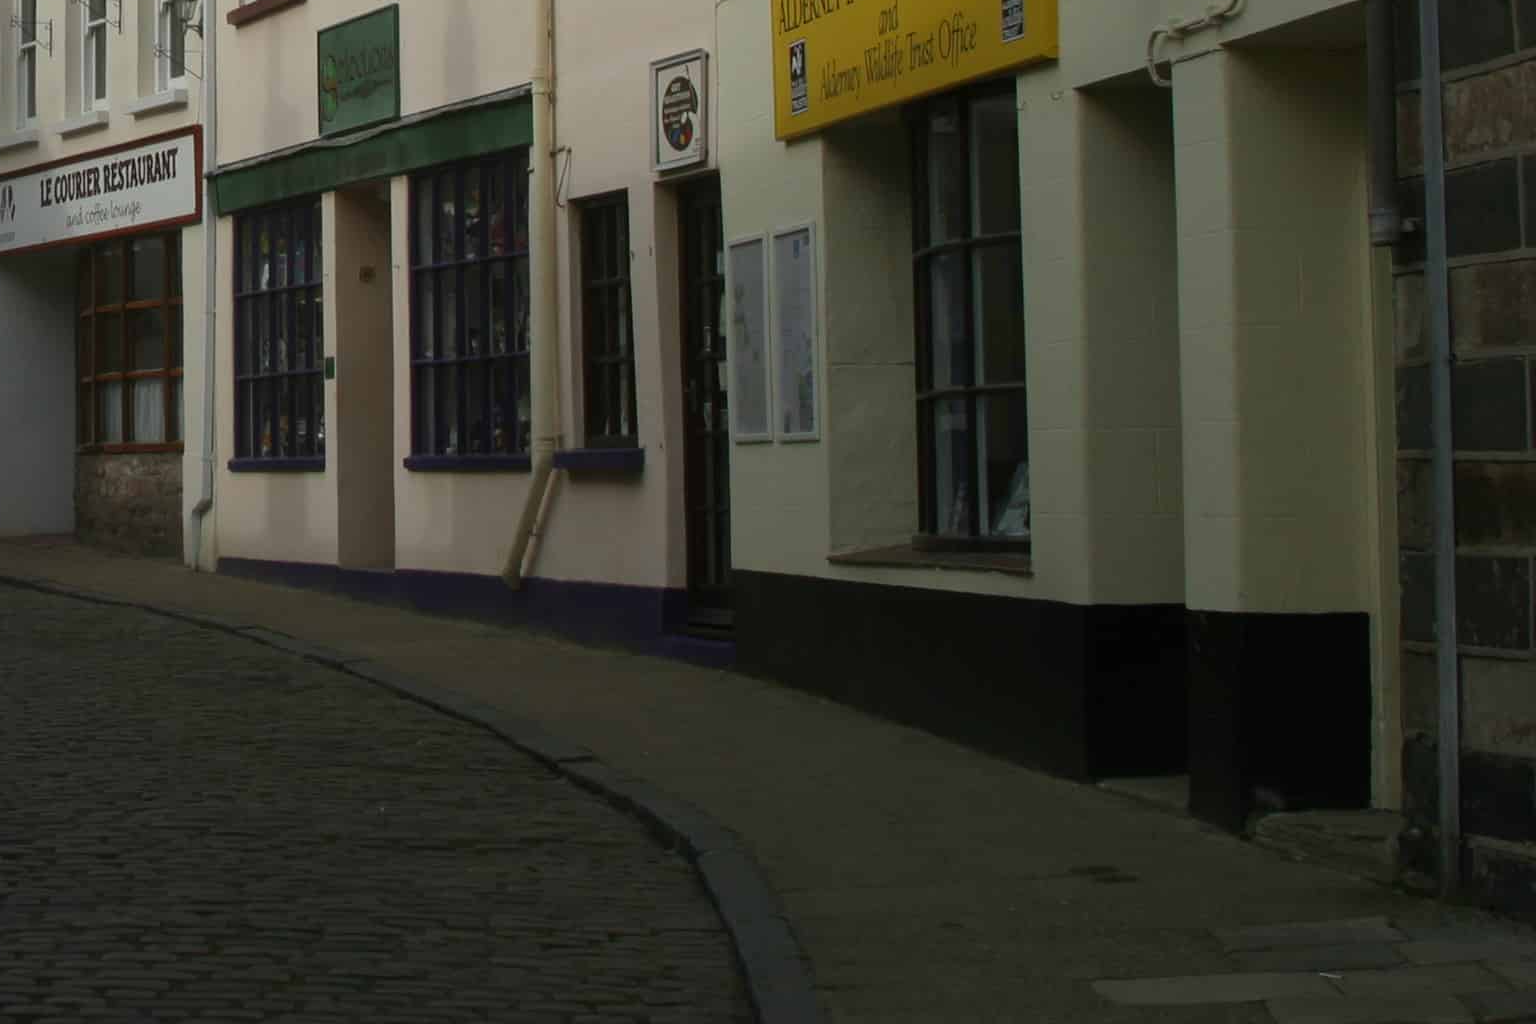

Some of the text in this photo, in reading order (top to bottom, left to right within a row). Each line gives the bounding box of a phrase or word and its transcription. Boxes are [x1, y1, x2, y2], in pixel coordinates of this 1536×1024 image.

[819, 57, 861, 104] Alderney
[864, 34, 904, 88] Wildlife
[906, 31, 935, 72] Trust
[938, 10, 977, 69] Office
[40, 147, 178, 207] LE COURIER RESTAURANT
[66, 199, 141, 227] and coffee lounge
